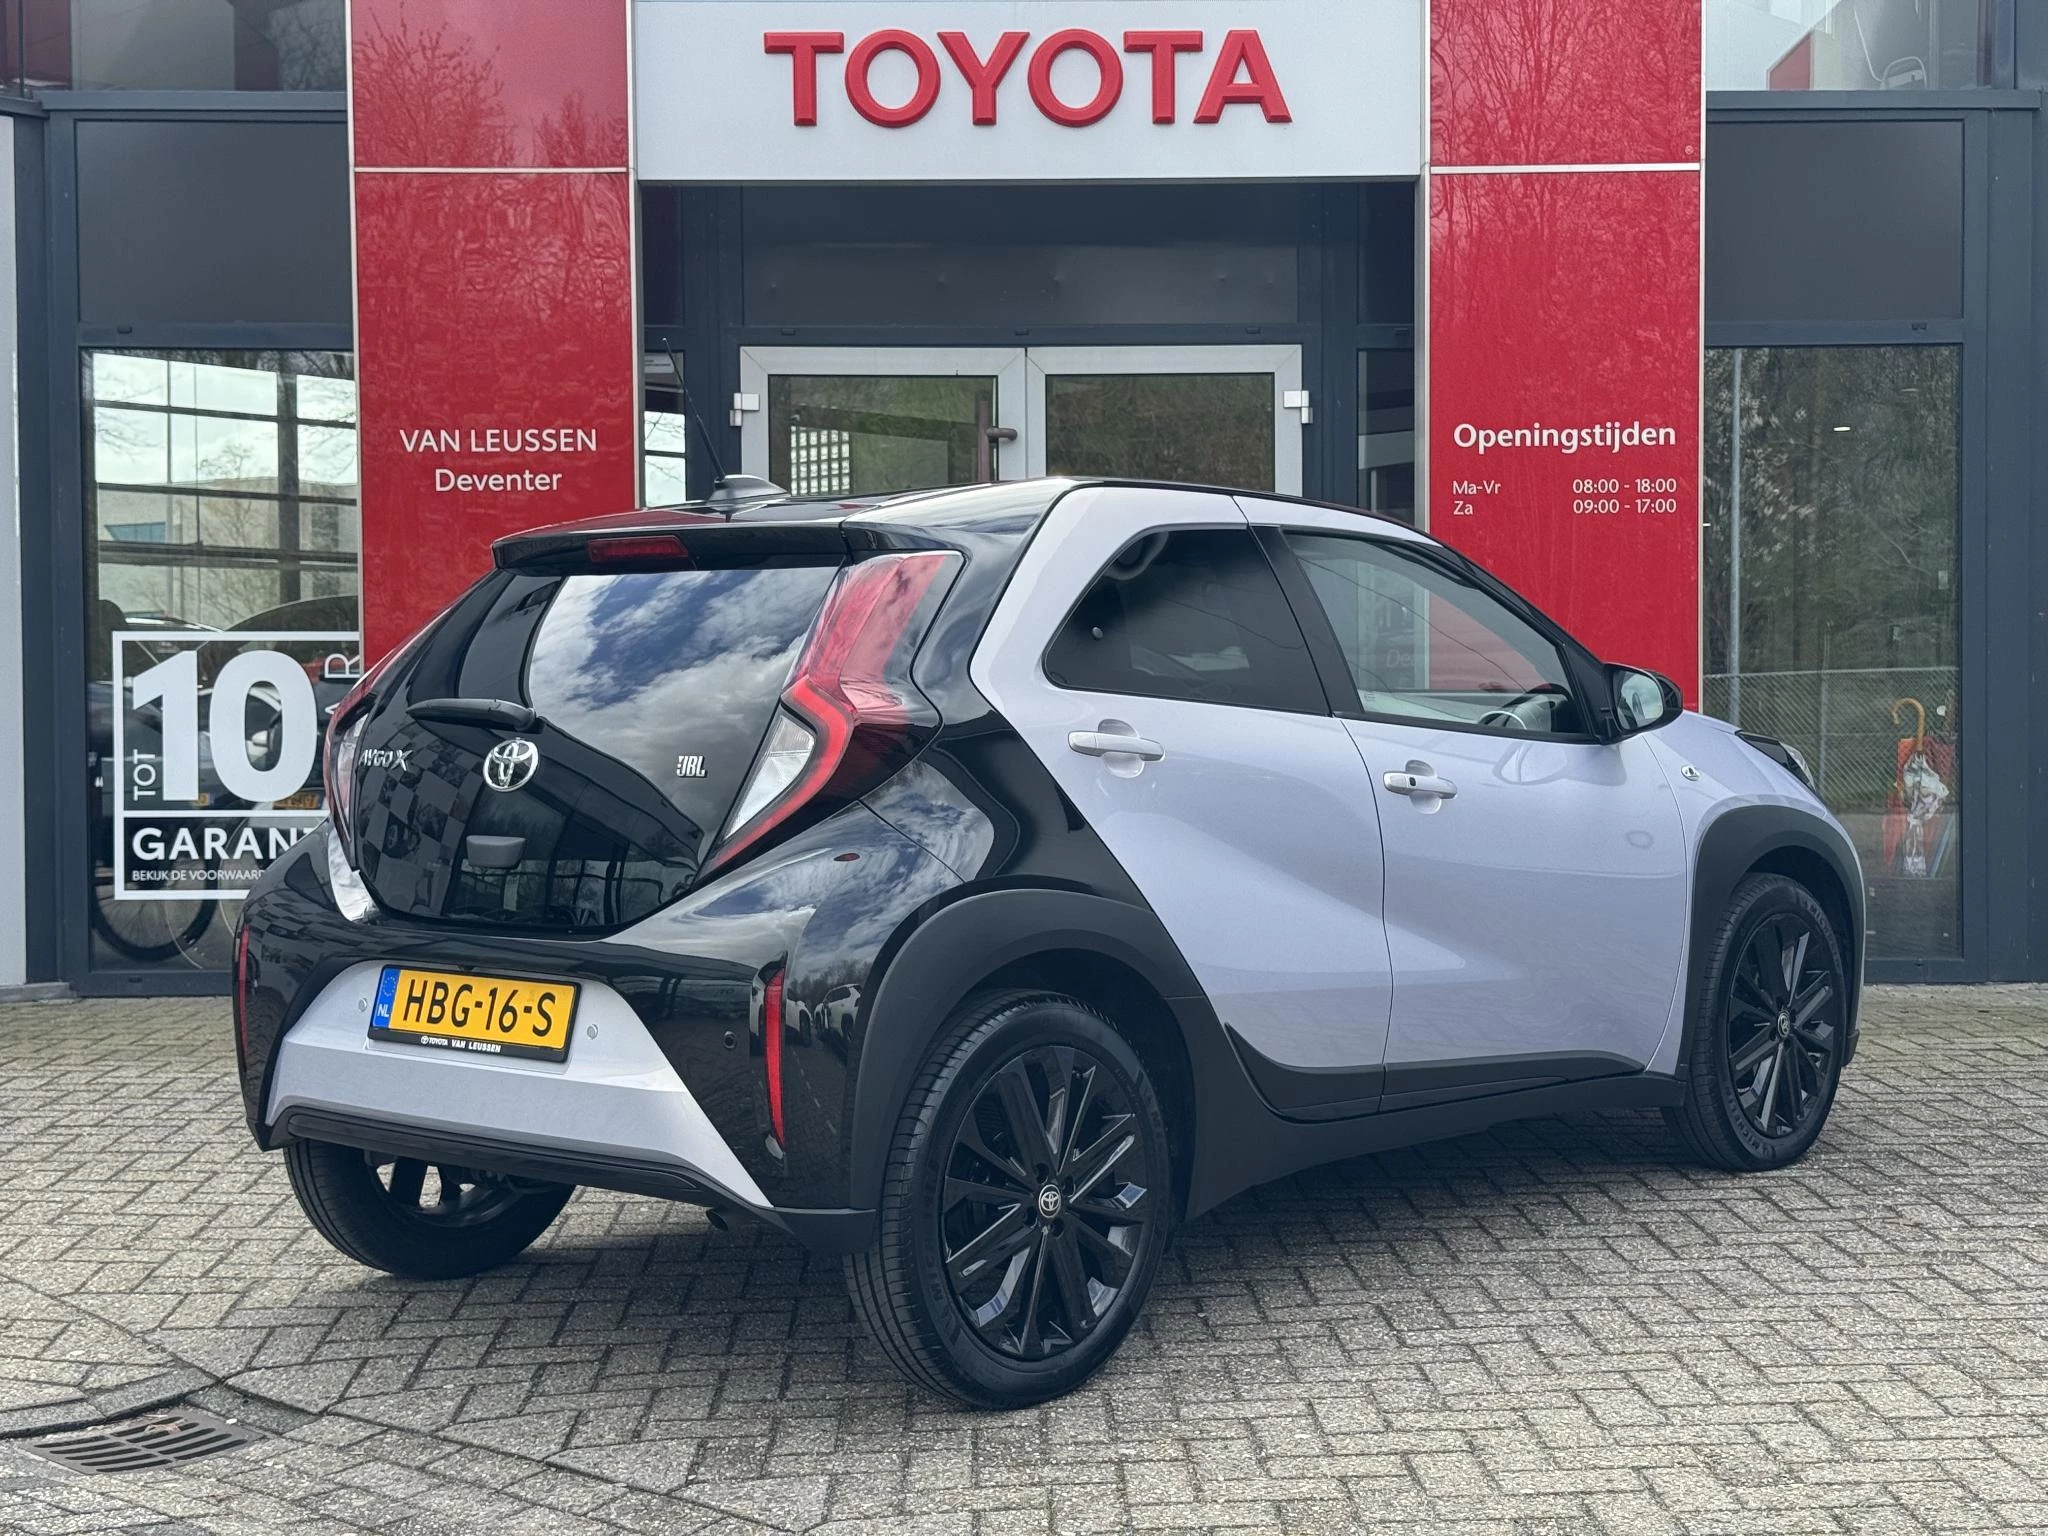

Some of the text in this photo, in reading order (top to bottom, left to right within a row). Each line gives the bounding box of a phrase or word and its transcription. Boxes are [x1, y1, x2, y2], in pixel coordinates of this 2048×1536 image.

[763, 29, 1293, 128] TOYOTA
[400, 429, 597, 452] VAN LEUSSEN
[1453, 421, 1676, 455] Openingstijden
[435, 469, 563, 492] Deventer
[1452, 480, 1501, 495] Ma-Vr
[1572, 479, 1620, 494] 08:00
[1635, 478, 1677, 493] 18:00
[1453, 500, 1474, 515] Za
[1572, 499, 1620, 514] 09:00
[1635, 498, 1677, 513] 17:00
[133, 650, 318, 802] 10
[133, 749, 156, 801] TOT
[676, 755, 706, 777] JBL
[132, 827, 314, 861] GARAN
[132, 869, 169, 881] BEKIJK
[170, 869, 187, 881] DE
[377, 1004, 389, 1018] NL
[403, 979, 556, 1037] HBG-16-S
[429, 1037, 501, 1053] TOYOTA VAN LEUSSEN
